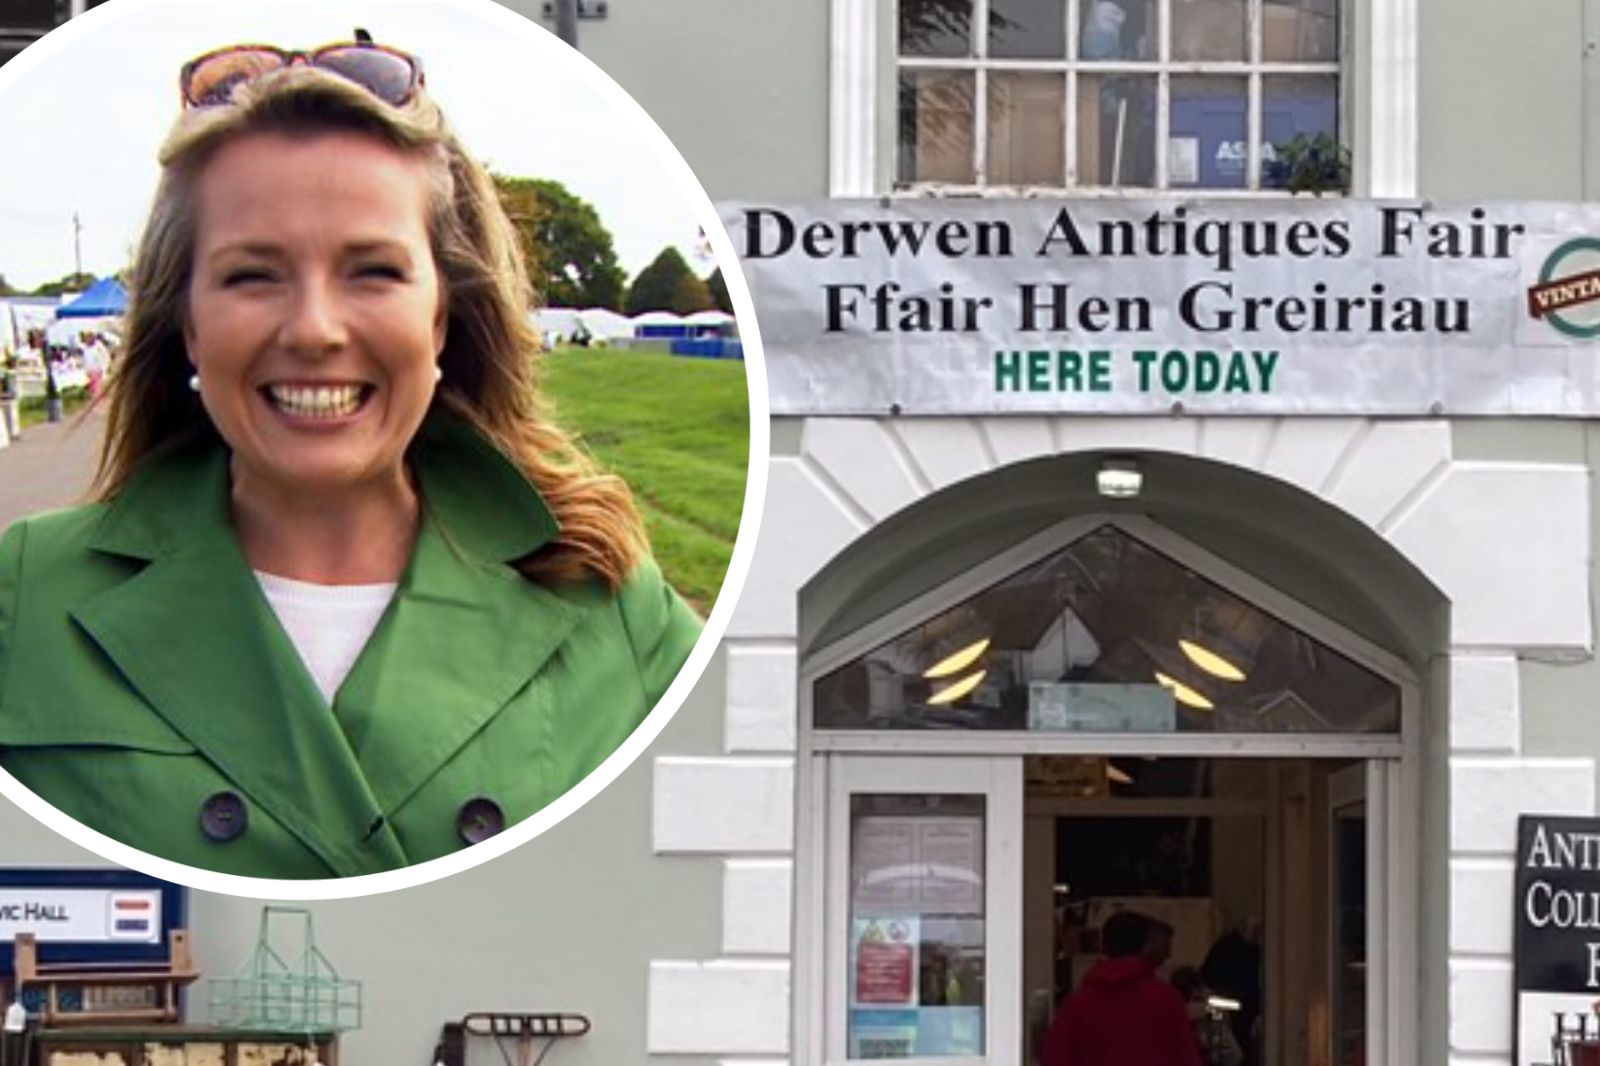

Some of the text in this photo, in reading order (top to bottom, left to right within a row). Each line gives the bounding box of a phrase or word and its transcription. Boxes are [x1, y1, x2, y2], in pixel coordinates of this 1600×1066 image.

[1216, 141, 1276, 161] ASA
[743, 206, 1526, 271] Derwen Antiques Fair
[823, 280, 1471, 333] Ffair Hen Greiriau
[994, 350, 1279, 392] HERE TODAY
[24, 902, 70, 922] HALL
